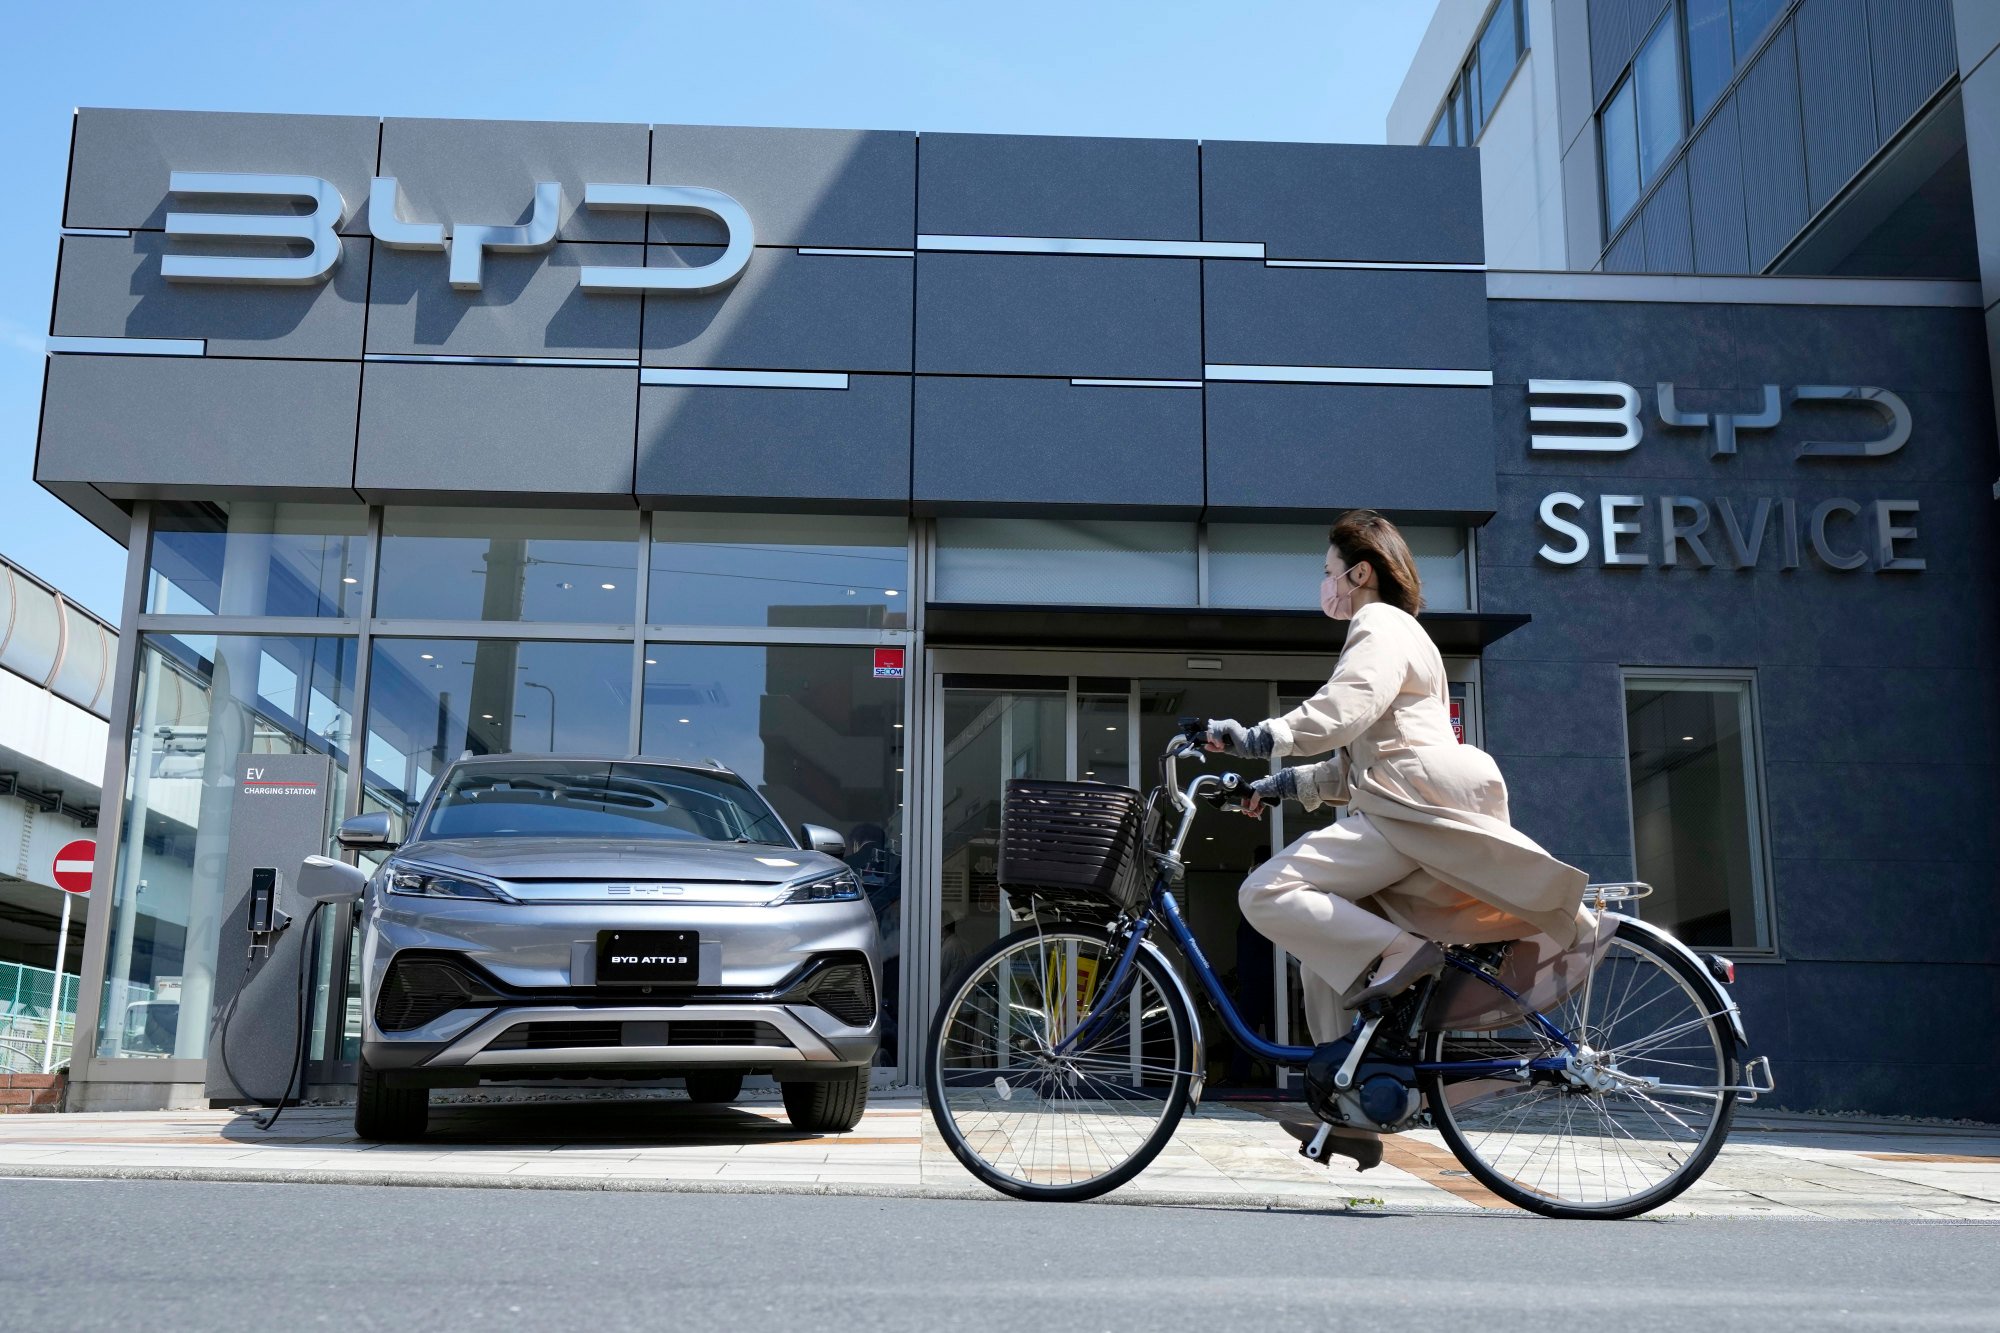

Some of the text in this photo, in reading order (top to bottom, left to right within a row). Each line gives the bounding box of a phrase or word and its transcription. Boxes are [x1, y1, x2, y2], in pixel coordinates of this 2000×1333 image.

[160, 170, 756, 294] BYD
[1528, 378, 1913, 460] BYD
[1538, 491, 1927, 572] SERVICE
[246, 768, 265, 780] EV
[244, 787, 317, 796] CHARGING STATION
[607, 885, 685, 895] BYD
[641, 956, 676, 964] ATTO
[678, 956, 688, 964] 3
[1188, 937, 1210, 969] Panasonic
